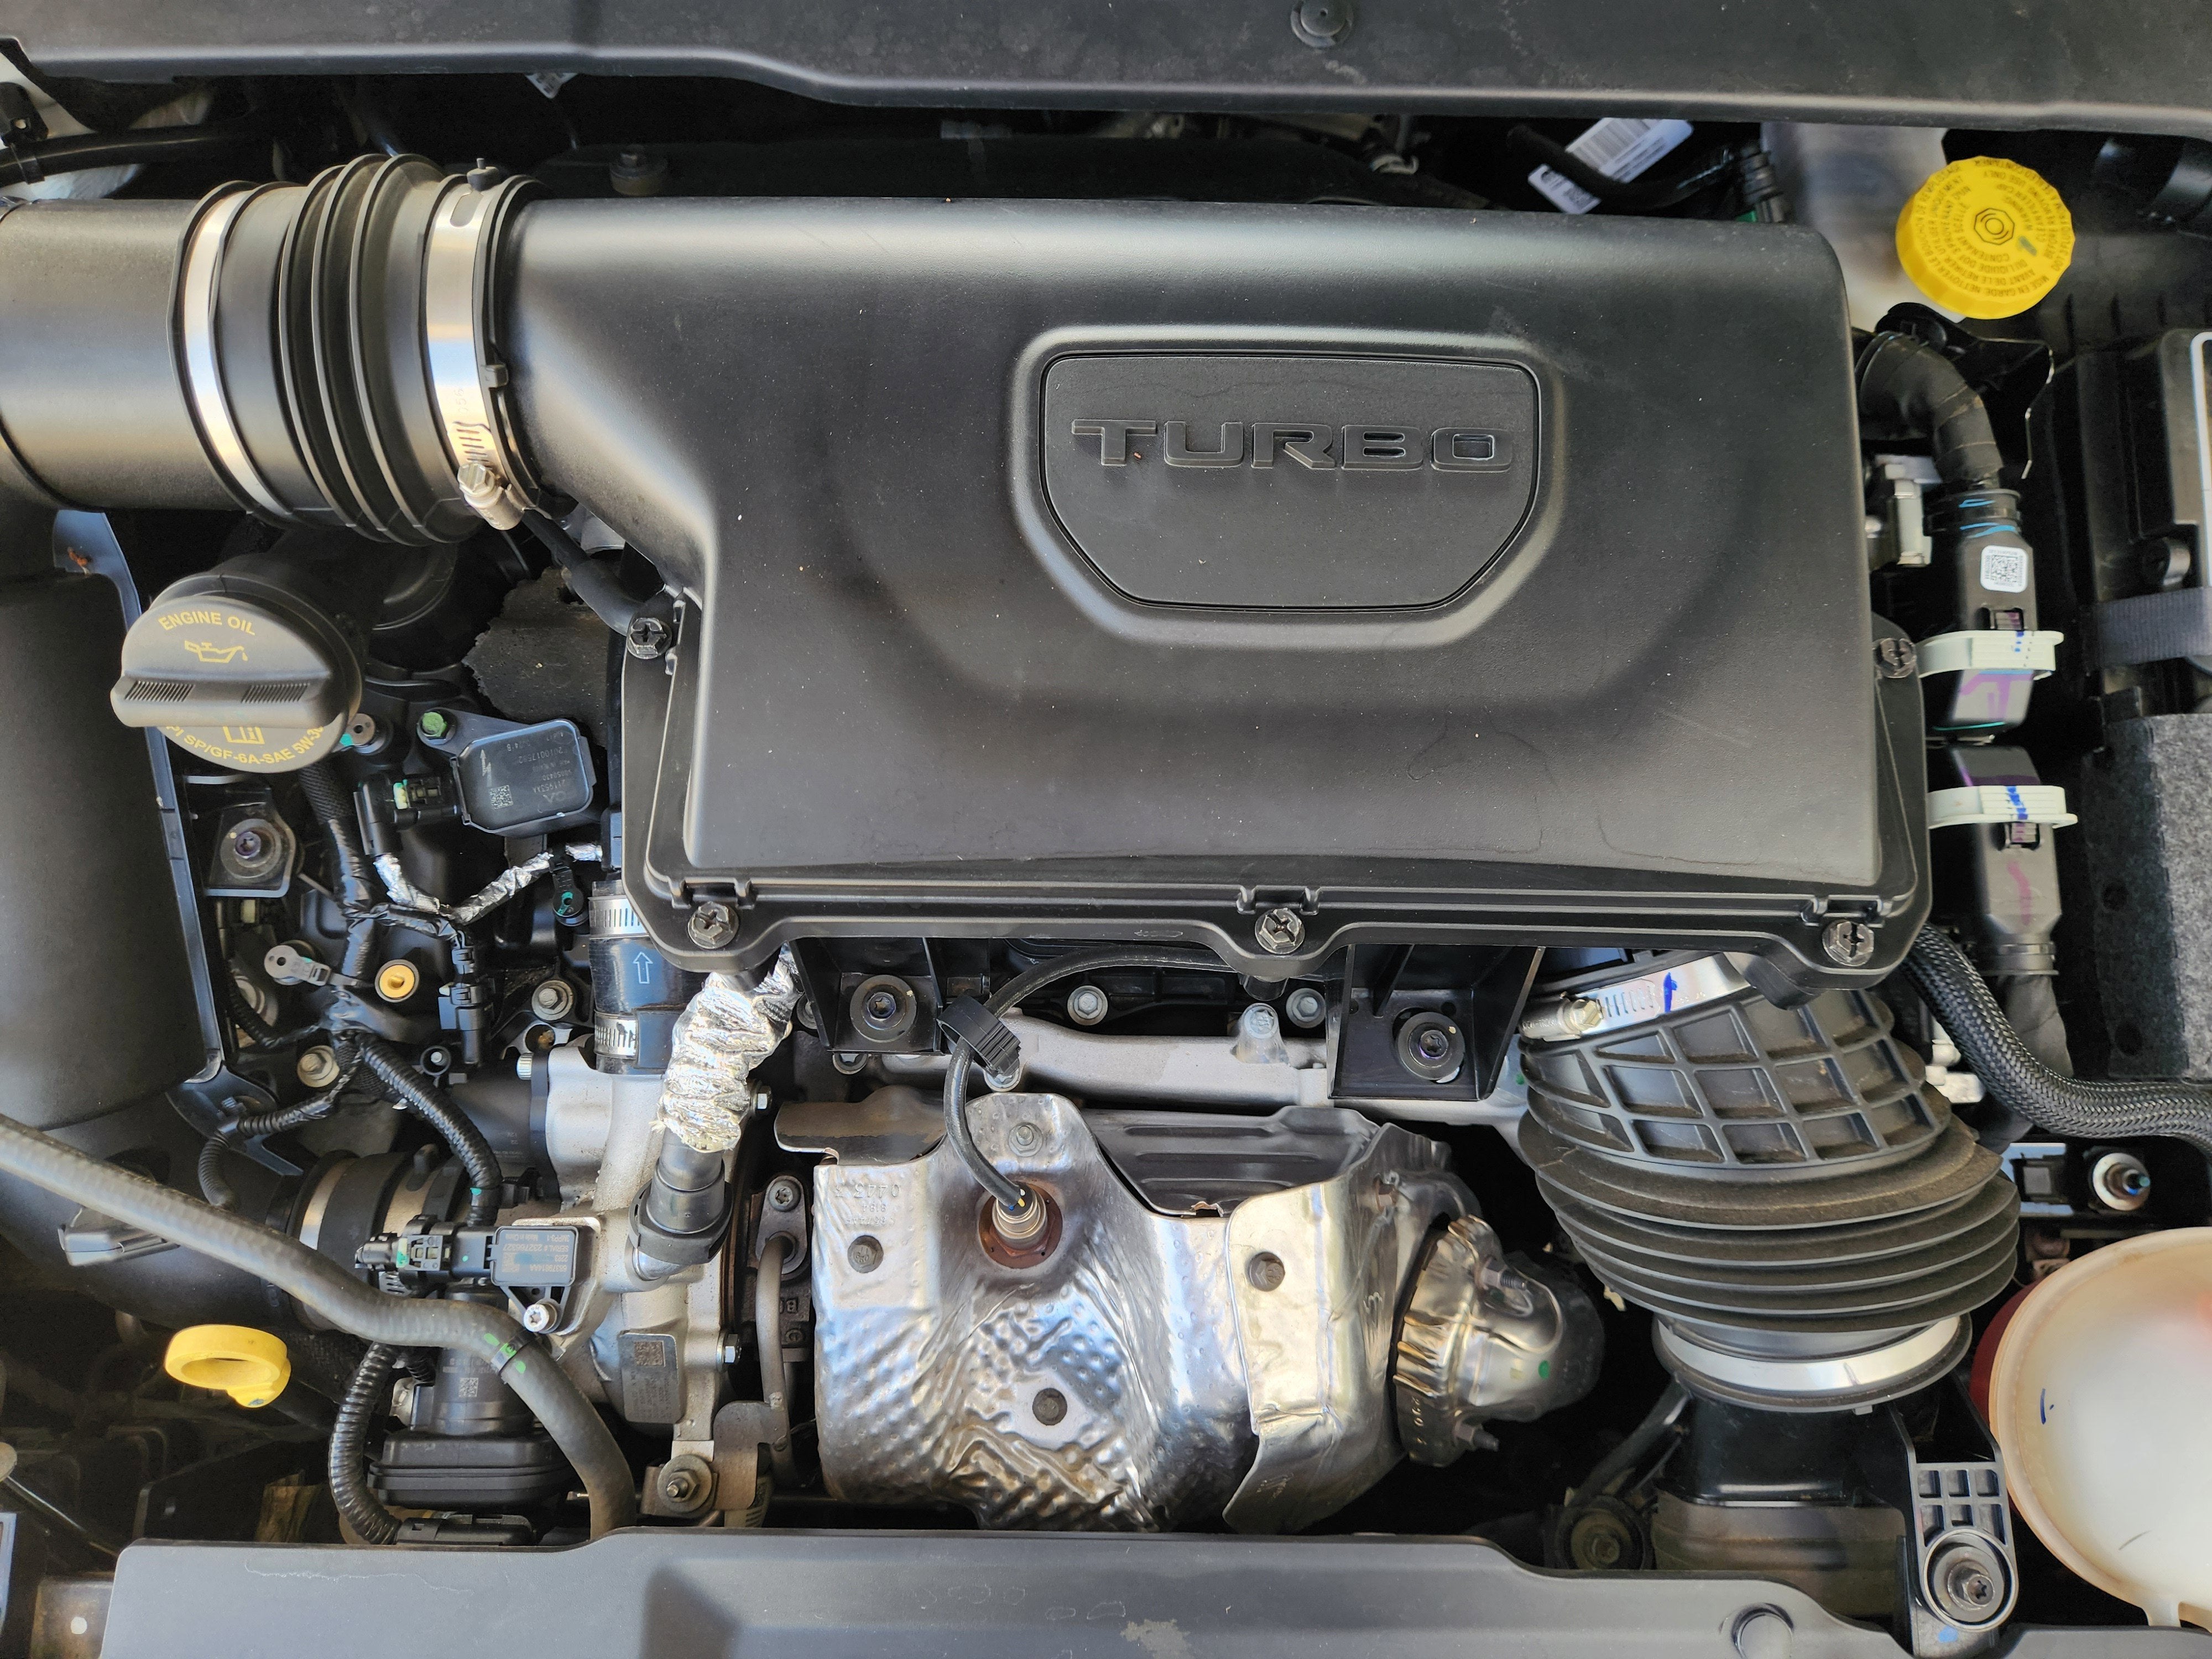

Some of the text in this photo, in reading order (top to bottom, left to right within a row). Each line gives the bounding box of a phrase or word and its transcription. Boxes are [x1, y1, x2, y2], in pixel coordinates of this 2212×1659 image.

[1071, 419, 1513, 472] TURBO
[158, 611, 255, 636] ENGINE OIL
